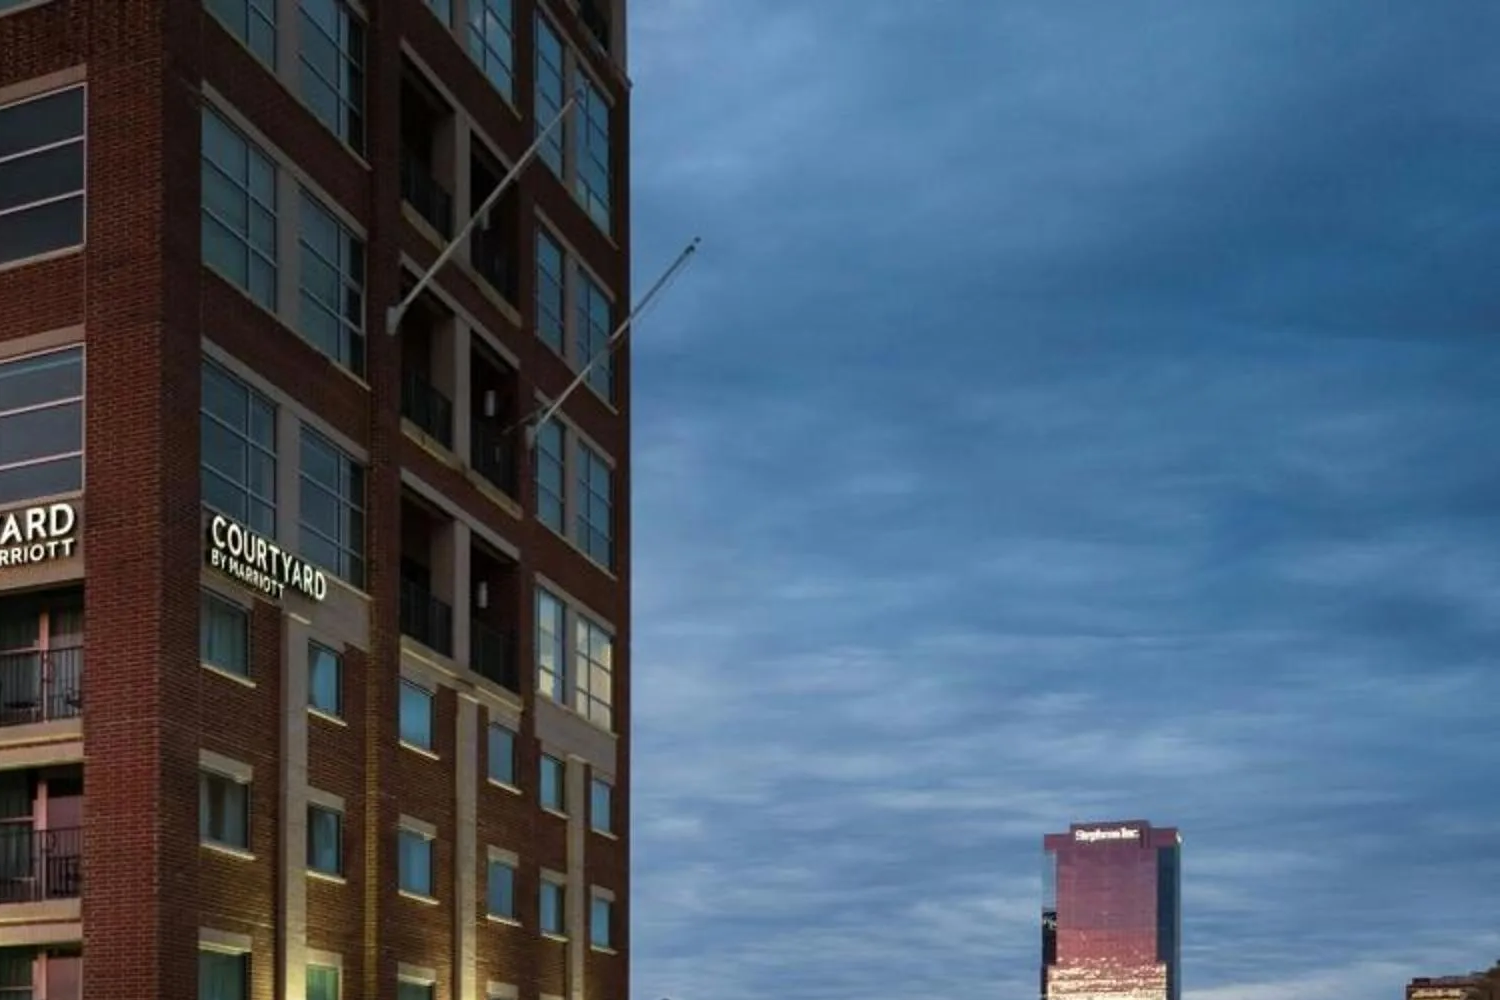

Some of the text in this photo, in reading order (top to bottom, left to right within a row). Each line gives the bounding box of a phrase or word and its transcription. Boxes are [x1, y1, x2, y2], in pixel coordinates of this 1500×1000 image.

[211, 514, 327, 601] COURTYARD
[211, 547, 285, 600] BY MARRIOTT
